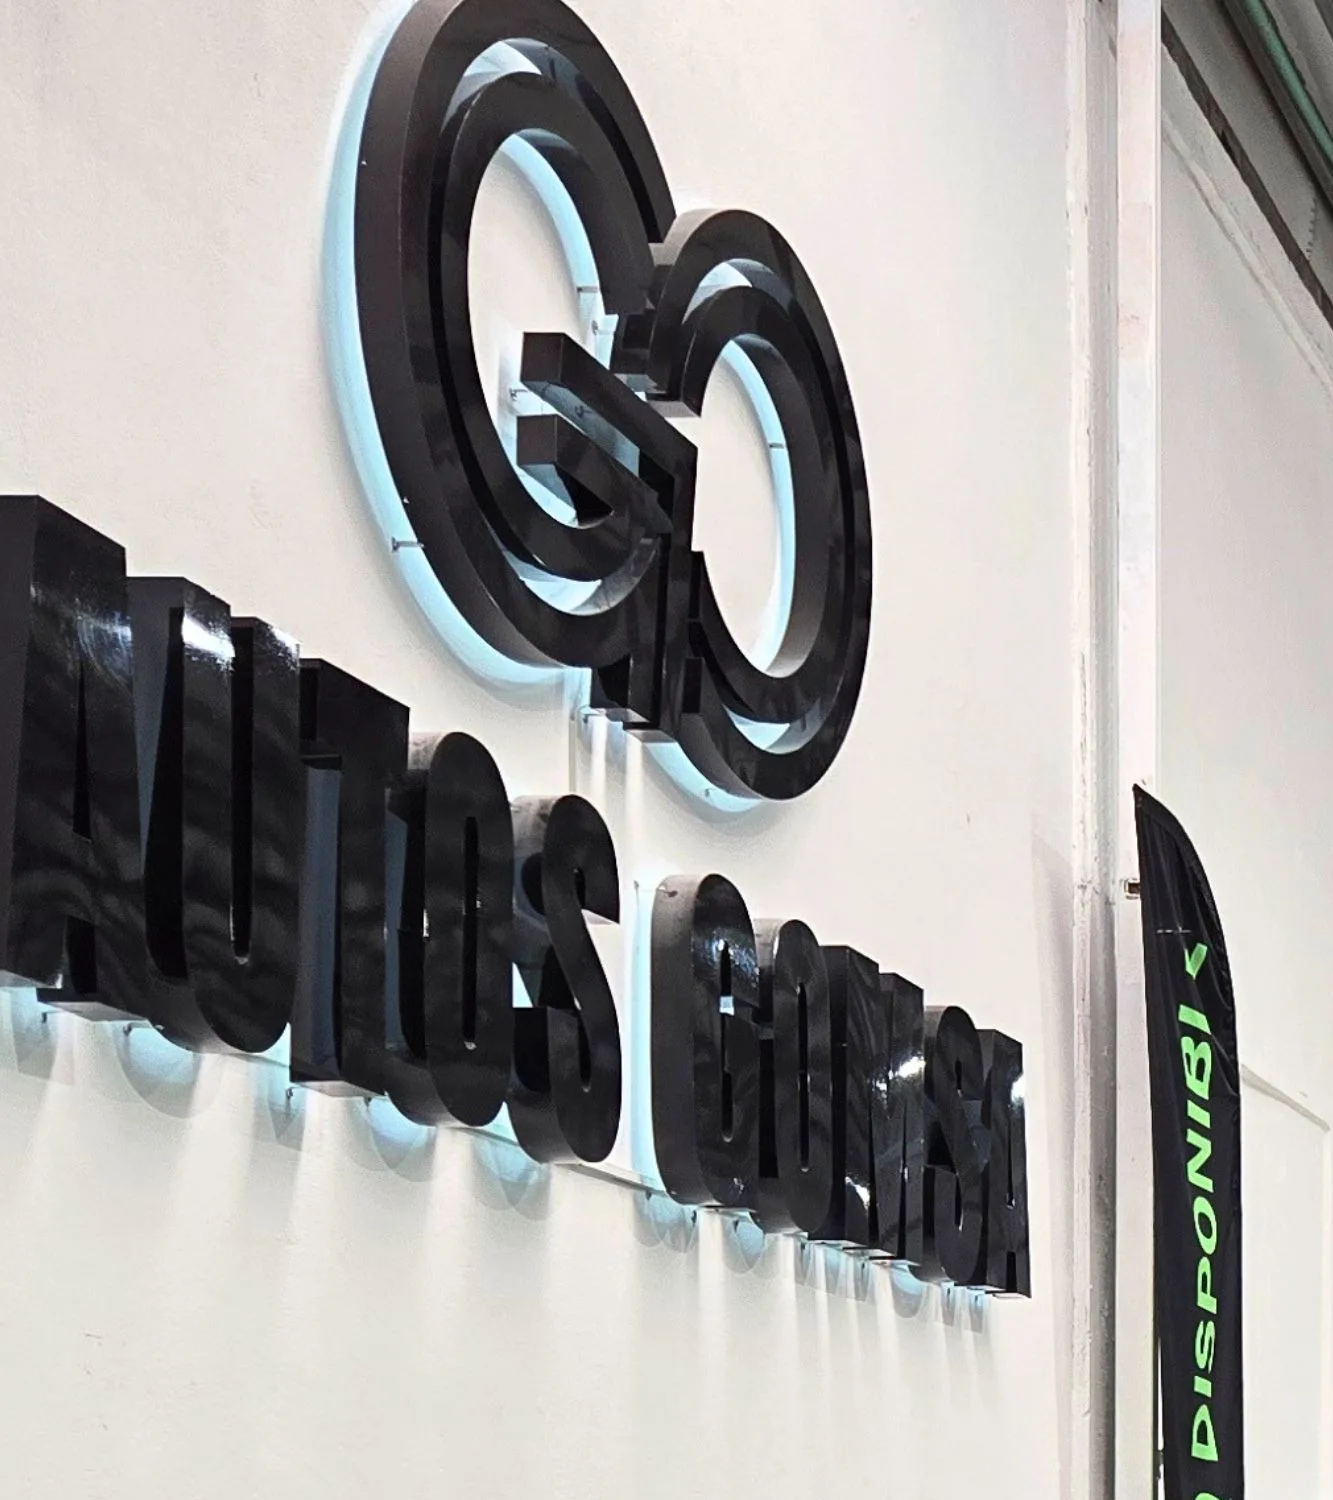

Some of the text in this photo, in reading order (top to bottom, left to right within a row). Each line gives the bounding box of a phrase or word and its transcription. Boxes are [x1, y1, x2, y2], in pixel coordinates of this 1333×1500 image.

[0, 494, 1031, 1298] AUTOS GOMSA
[1178, 942, 1219, 1463] DISPONIB
